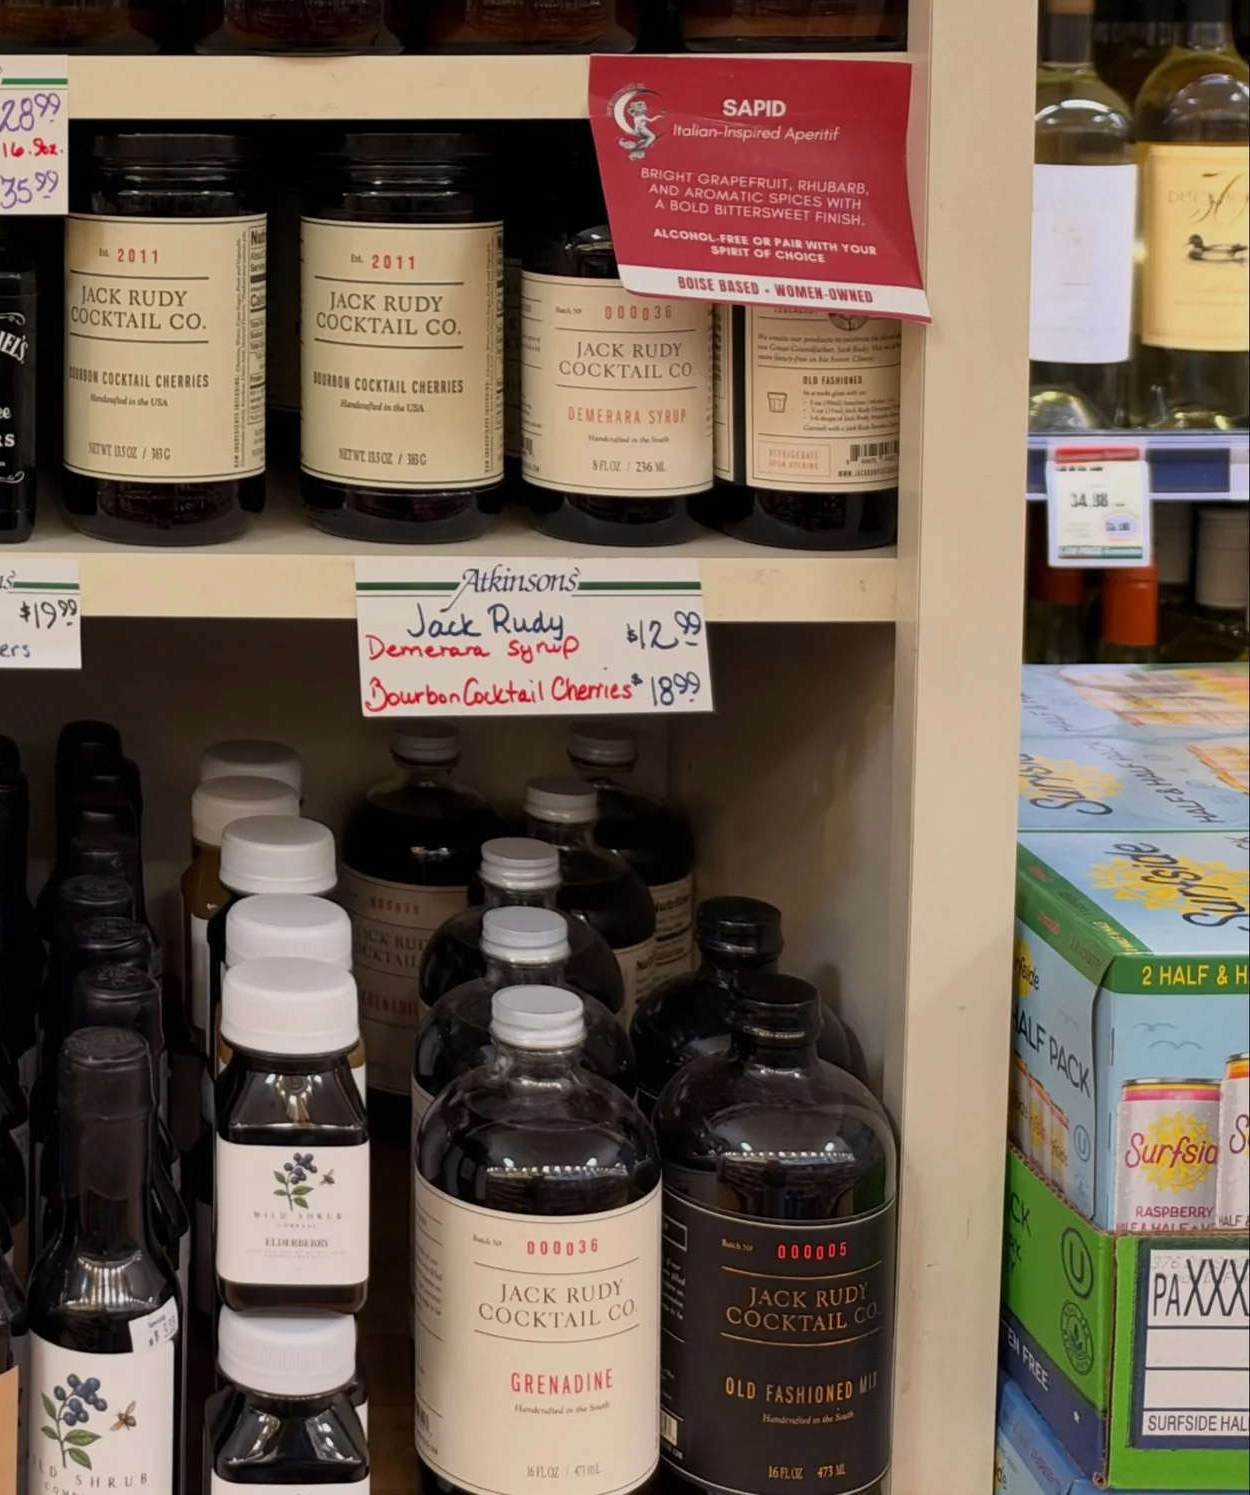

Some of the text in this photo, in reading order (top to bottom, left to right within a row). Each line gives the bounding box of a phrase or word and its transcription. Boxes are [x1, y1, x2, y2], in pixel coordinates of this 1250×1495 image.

[723, 100, 786, 118] SAPID
[672, 124, 840, 143] Italian-Inspired Aperitif
[669, 200, 865, 226] BOLD BITTERSWEET FINISH.
[118, 248, 160, 264] 2011
[80, 286, 188, 308] JACK RUDY
[678, 276, 873, 303] BOISE BASED WOMEN-OWNED
[71, 307, 162, 330] COCKTAIL
[103, 372, 209, 389] COCKTAIL CHERRIES
[568, 407, 686, 425] DEMERARA SYRUP
[407, 602, 564, 643] Jack Rudy
[1142, 965, 1228, 985] 2 HALF &
[1136, 1207, 1213, 1218] RASPBERRY
[498, 1278, 624, 1305] JACK RUDY
[748, 1281, 868, 1308] JACK RUDY
[510, 1367, 614, 1395] GRENADINE
[725, 1376, 854, 1404] OLD FASHIONED
[1148, 1415, 1217, 1431] SURFSIDE
